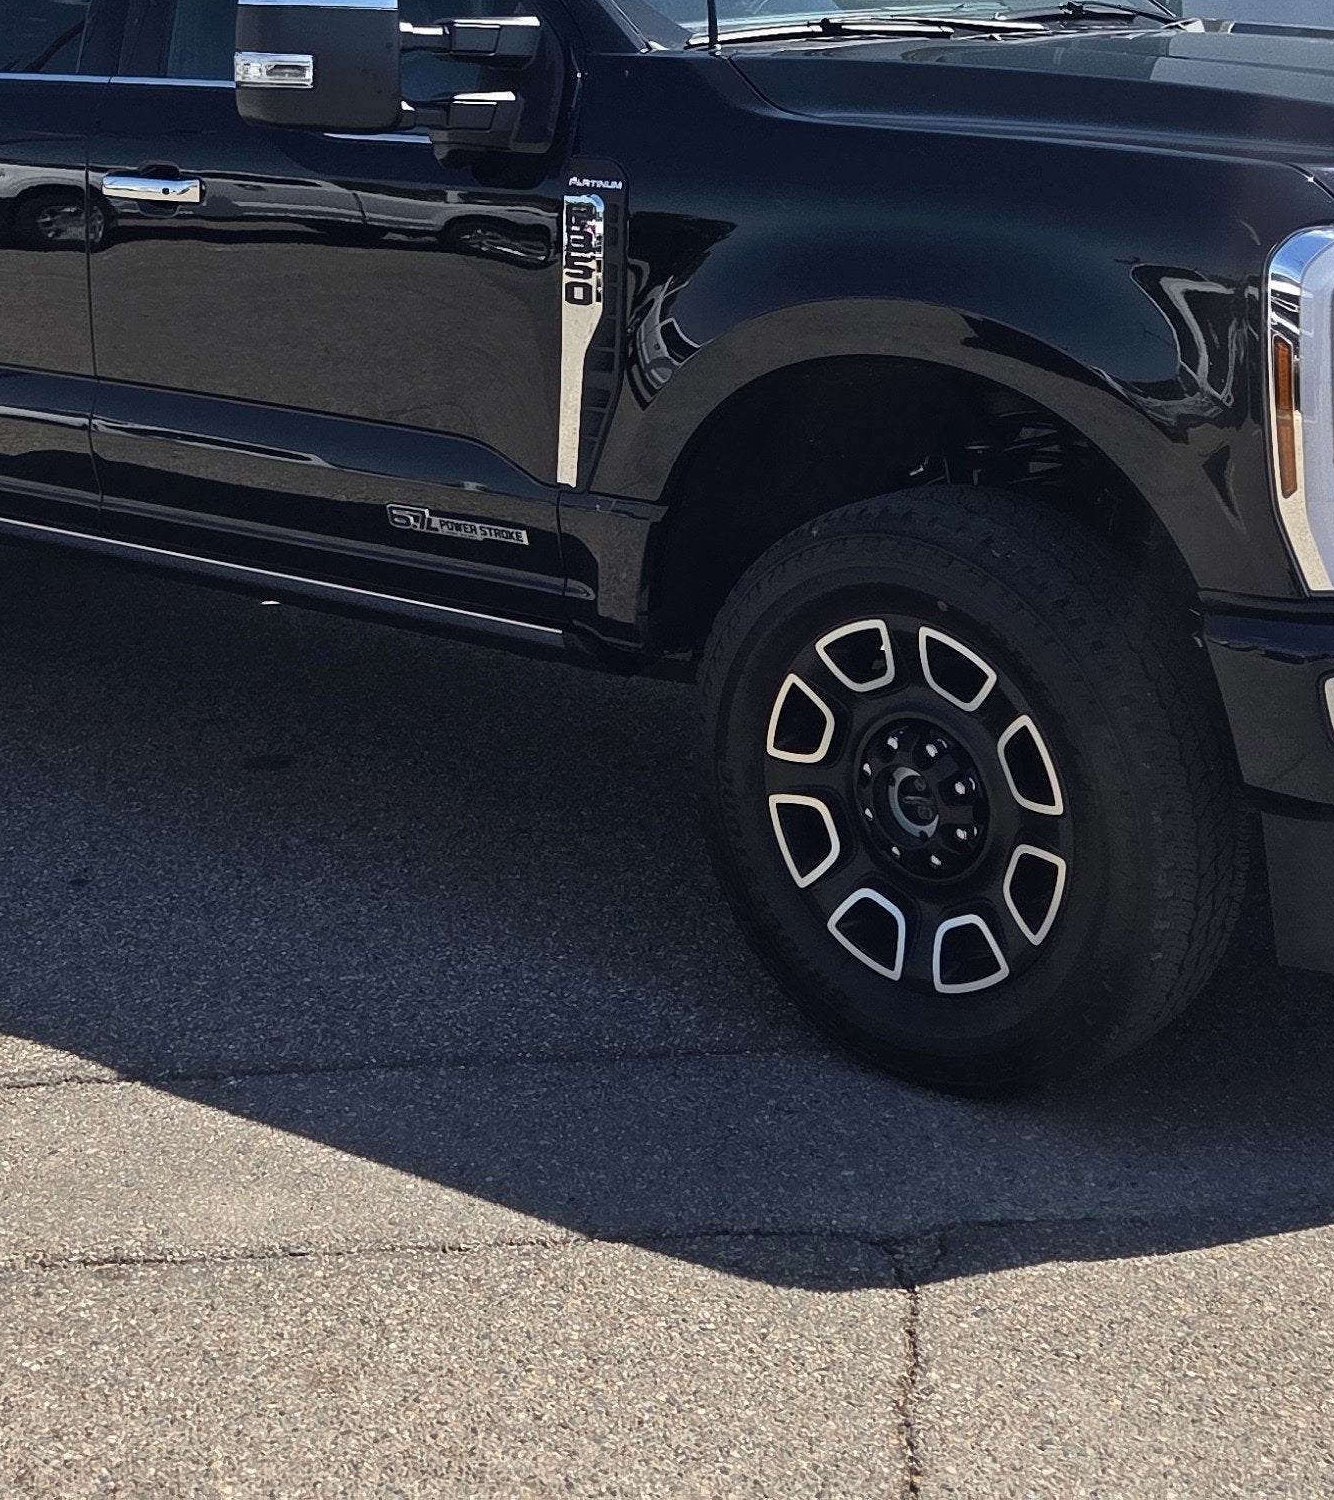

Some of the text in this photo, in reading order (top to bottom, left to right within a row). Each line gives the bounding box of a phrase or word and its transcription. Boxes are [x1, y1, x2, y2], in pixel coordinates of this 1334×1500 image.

[569, 176, 623, 190] PLATINUM
[387, 504, 439, 532] 6.7L
[439, 519, 478, 535] POWER
[480, 525, 524, 543] STROKE
